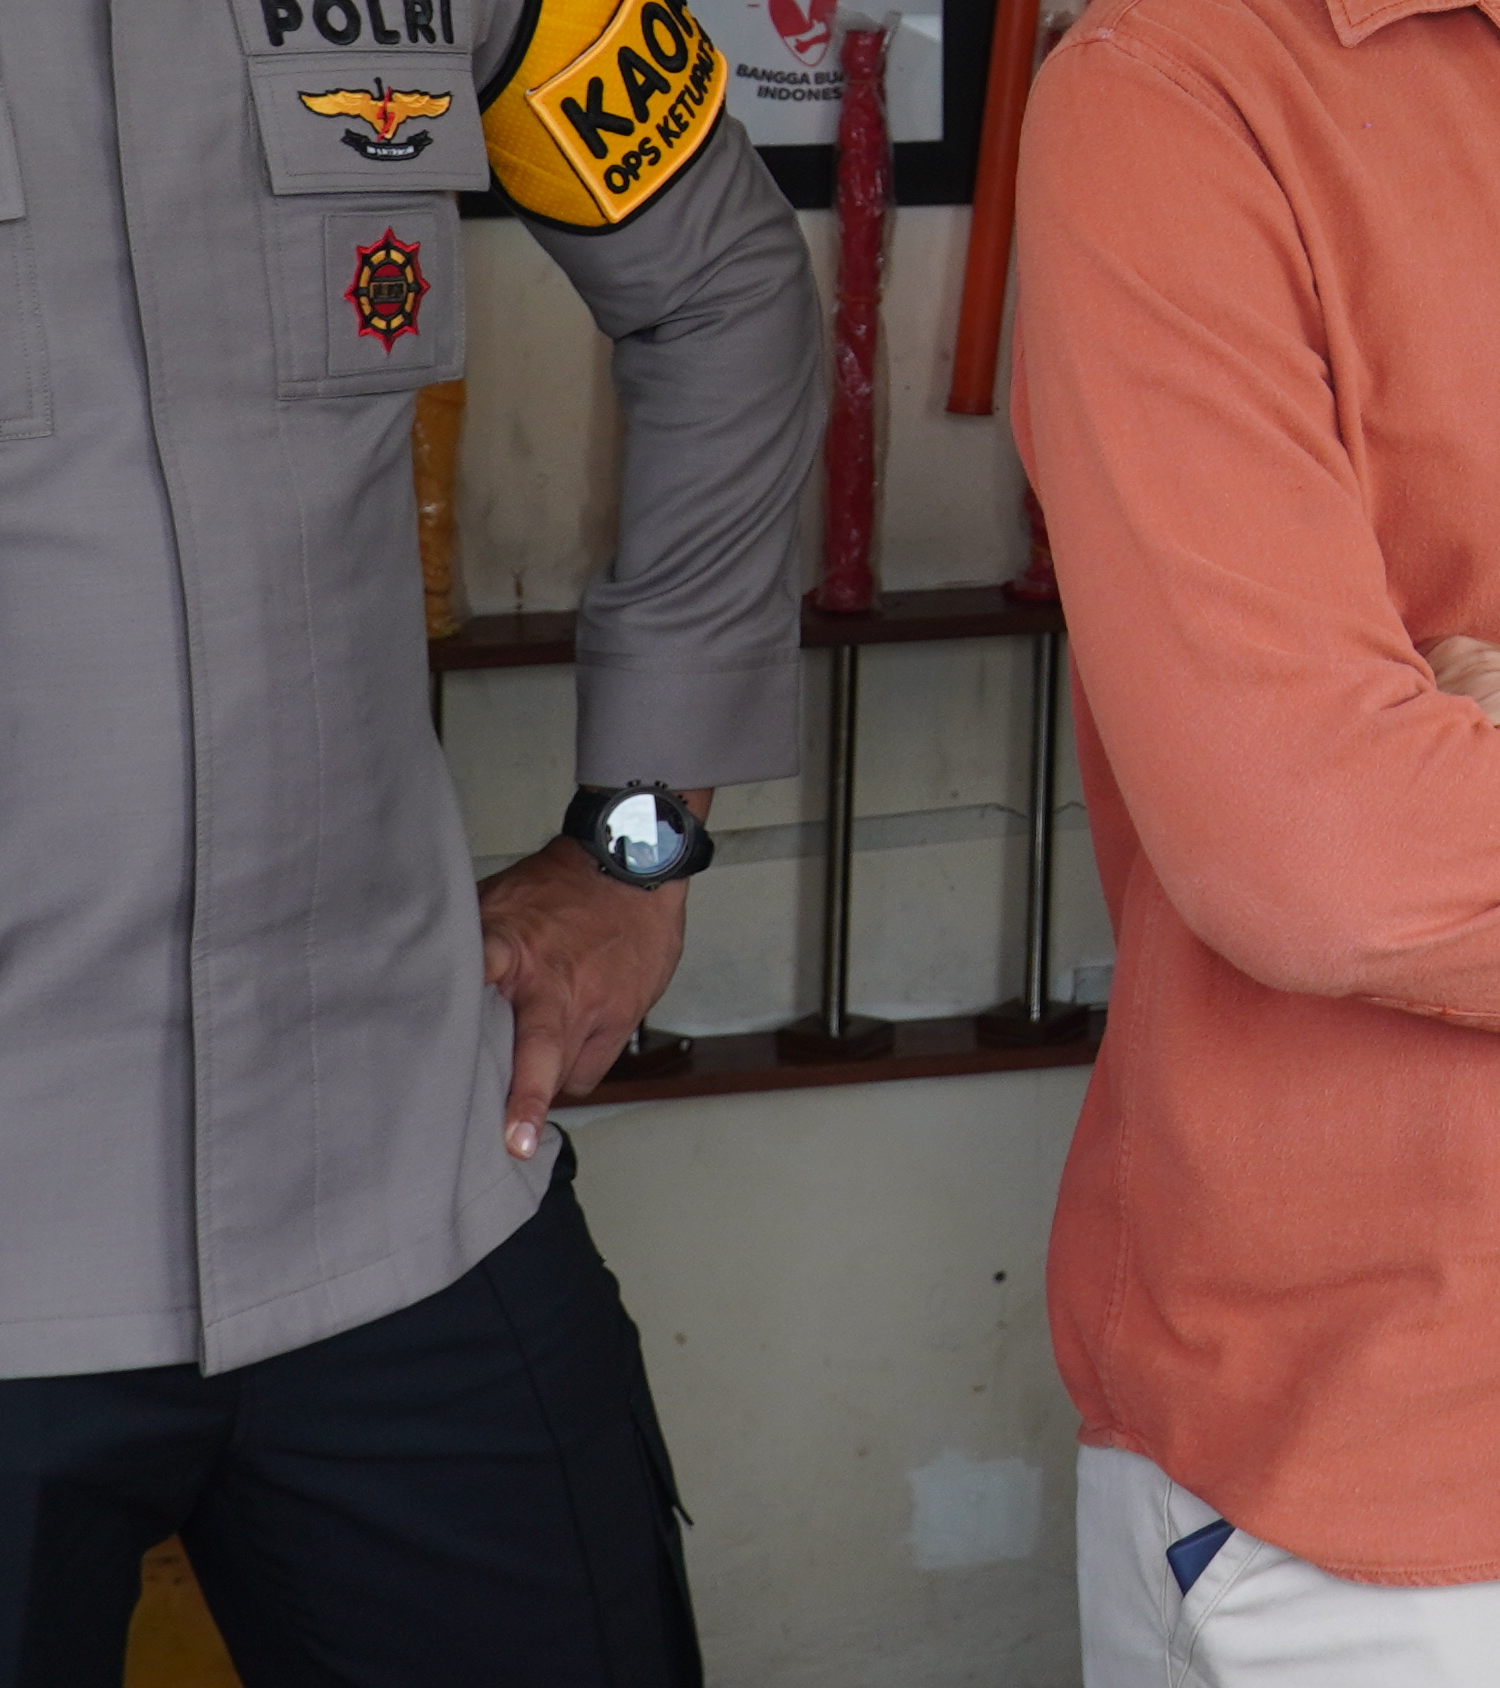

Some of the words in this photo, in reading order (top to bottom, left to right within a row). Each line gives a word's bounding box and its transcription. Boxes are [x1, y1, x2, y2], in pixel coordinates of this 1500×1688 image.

[736, 63, 811, 86] BANGGA
[756, 85, 842, 101] INDONES
[603, 136, 662, 195] OPS
